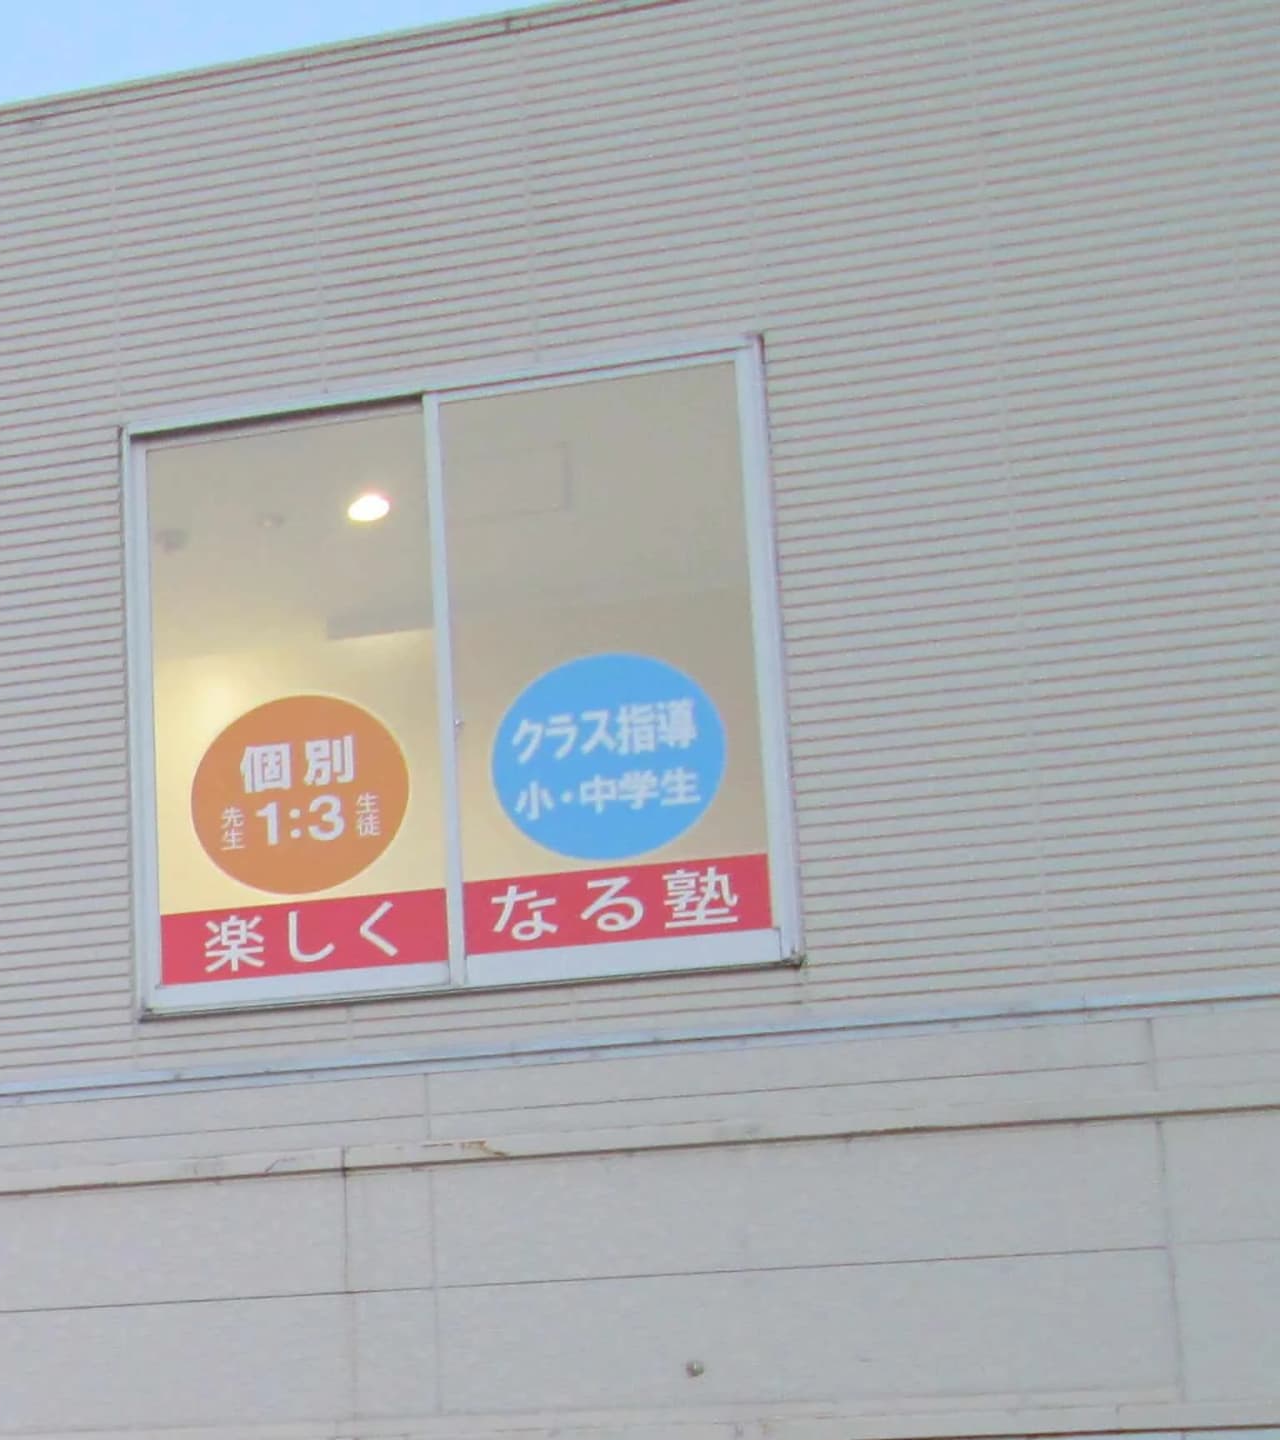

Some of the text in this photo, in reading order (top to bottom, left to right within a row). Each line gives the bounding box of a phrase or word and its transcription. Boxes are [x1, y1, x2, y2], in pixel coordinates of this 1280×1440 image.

[512, 697, 697, 763] クラス指導
[240, 735, 355, 794] 個別
[221, 792, 381, 851] 先生 1:3 生徒
[514, 767, 702, 822] 小・中学生
[204, 867, 739, 973] 楽しく なる塾
